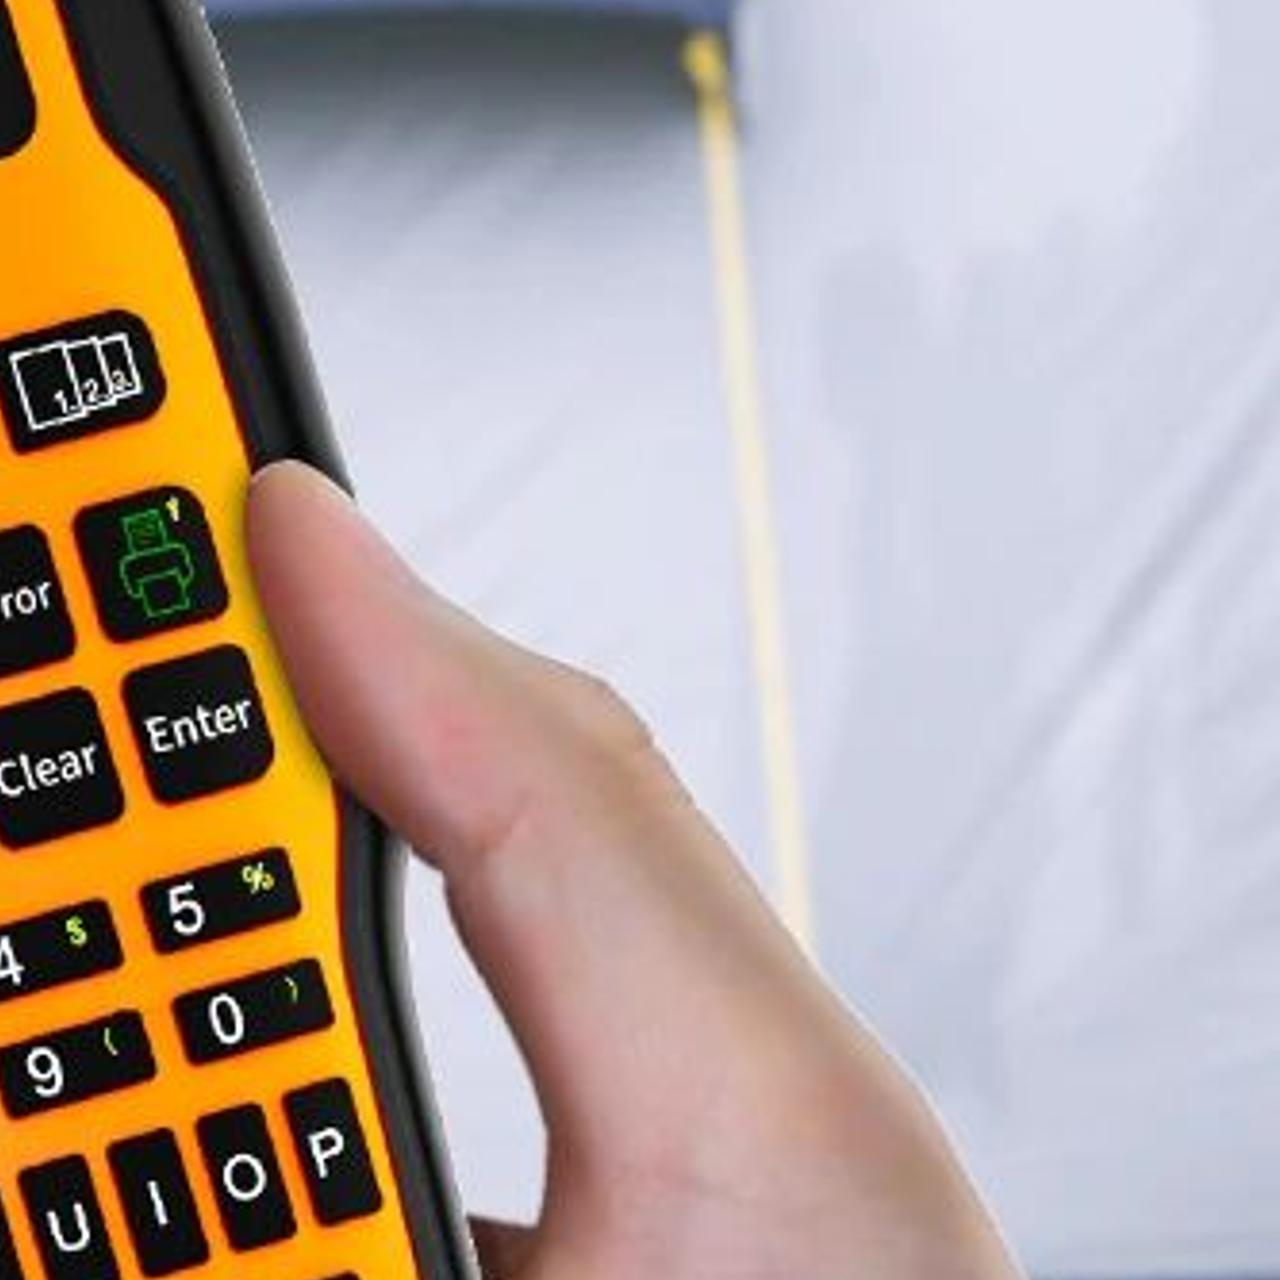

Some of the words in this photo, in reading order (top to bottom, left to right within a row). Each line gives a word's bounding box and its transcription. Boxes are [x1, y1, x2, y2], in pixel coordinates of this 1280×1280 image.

[143, 698, 253, 754] Enter
[167, 881, 206, 937] 5
[240, 860, 276, 895] %
[207, 992, 246, 1046] 0
[25, 1045, 65, 1099] 9
[221, 1152, 268, 1203] O
[306, 1126, 346, 1180] P
[45, 1201, 92, 1253] U
[146, 1179, 170, 1227] I
